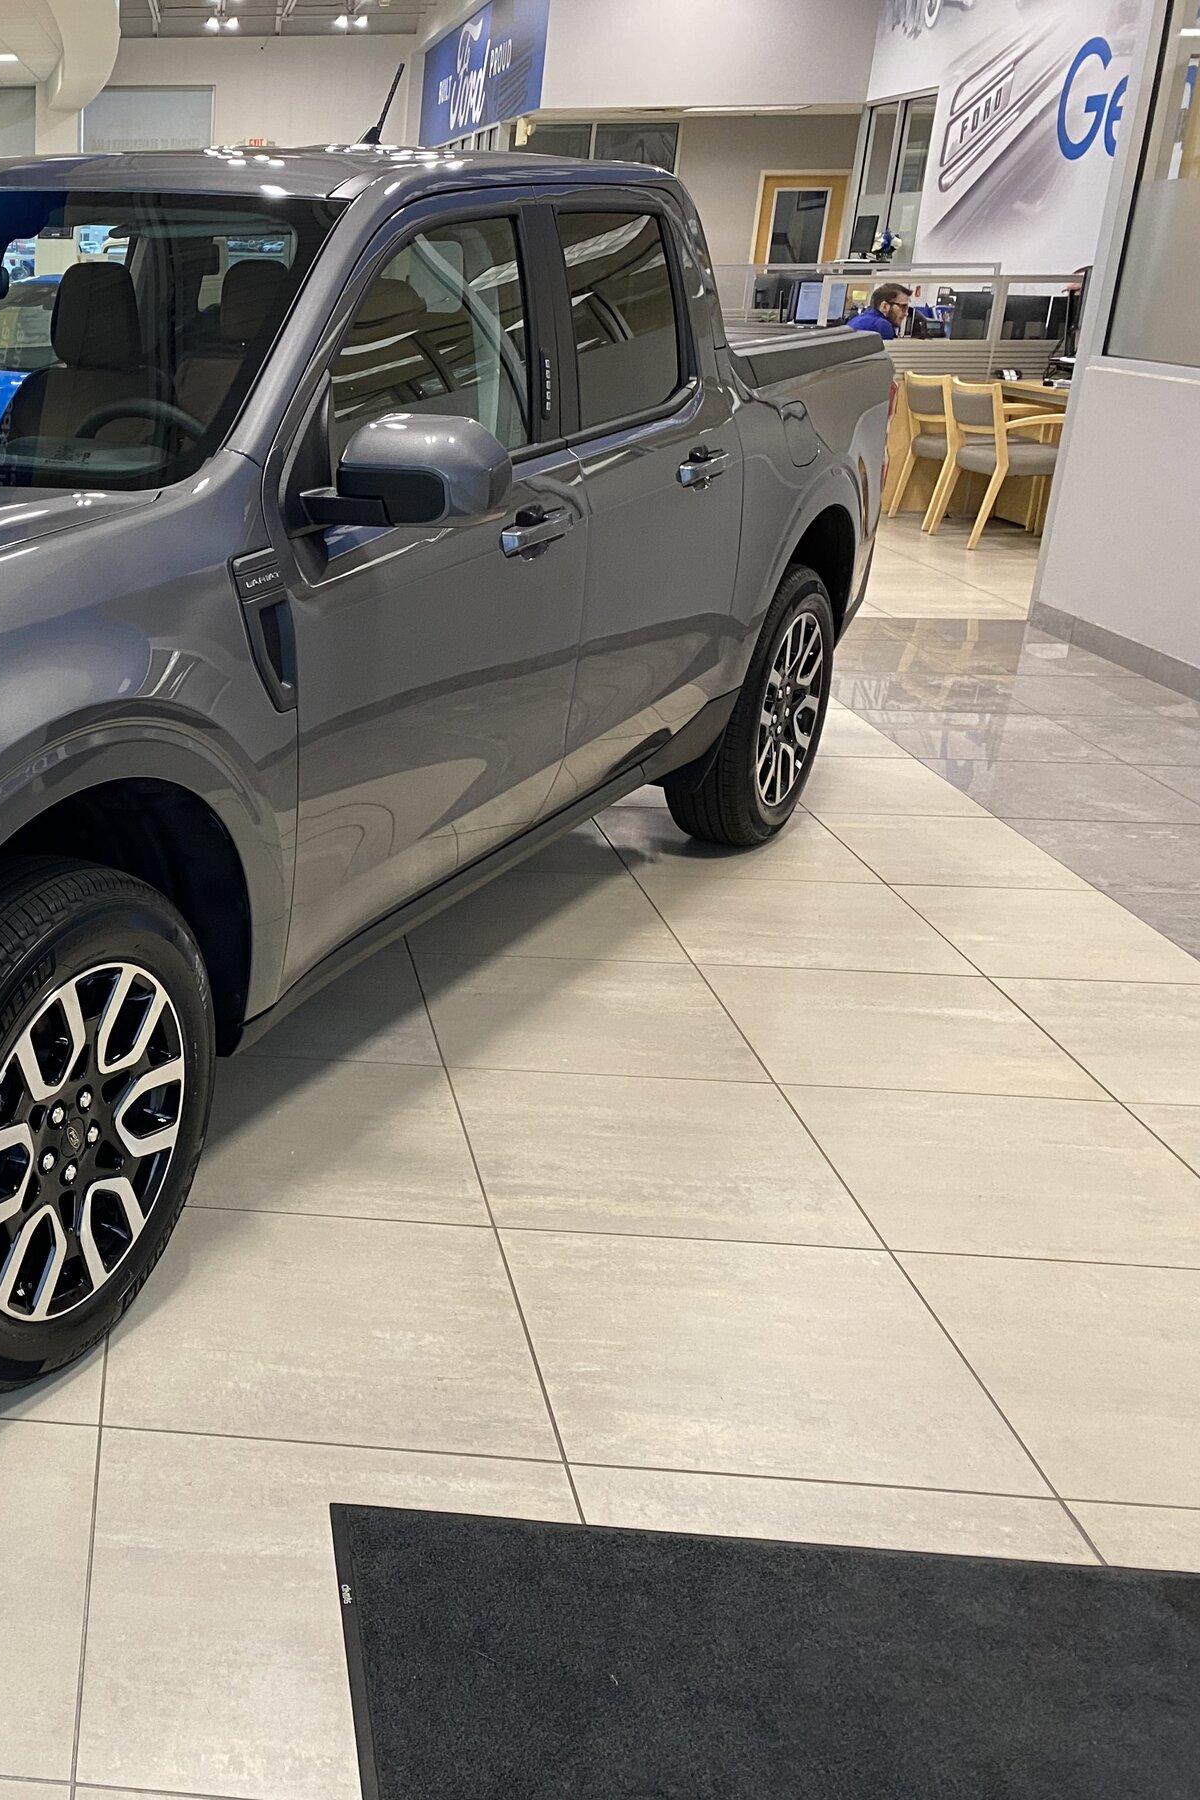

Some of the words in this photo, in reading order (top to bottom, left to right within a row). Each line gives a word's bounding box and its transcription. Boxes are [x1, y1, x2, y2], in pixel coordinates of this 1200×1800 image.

[449, 17, 491, 131] Ford
[489, 38, 512, 79] PROUD
[958, 87, 1004, 144] FORD
[245, 570, 281, 589] LARIAT
